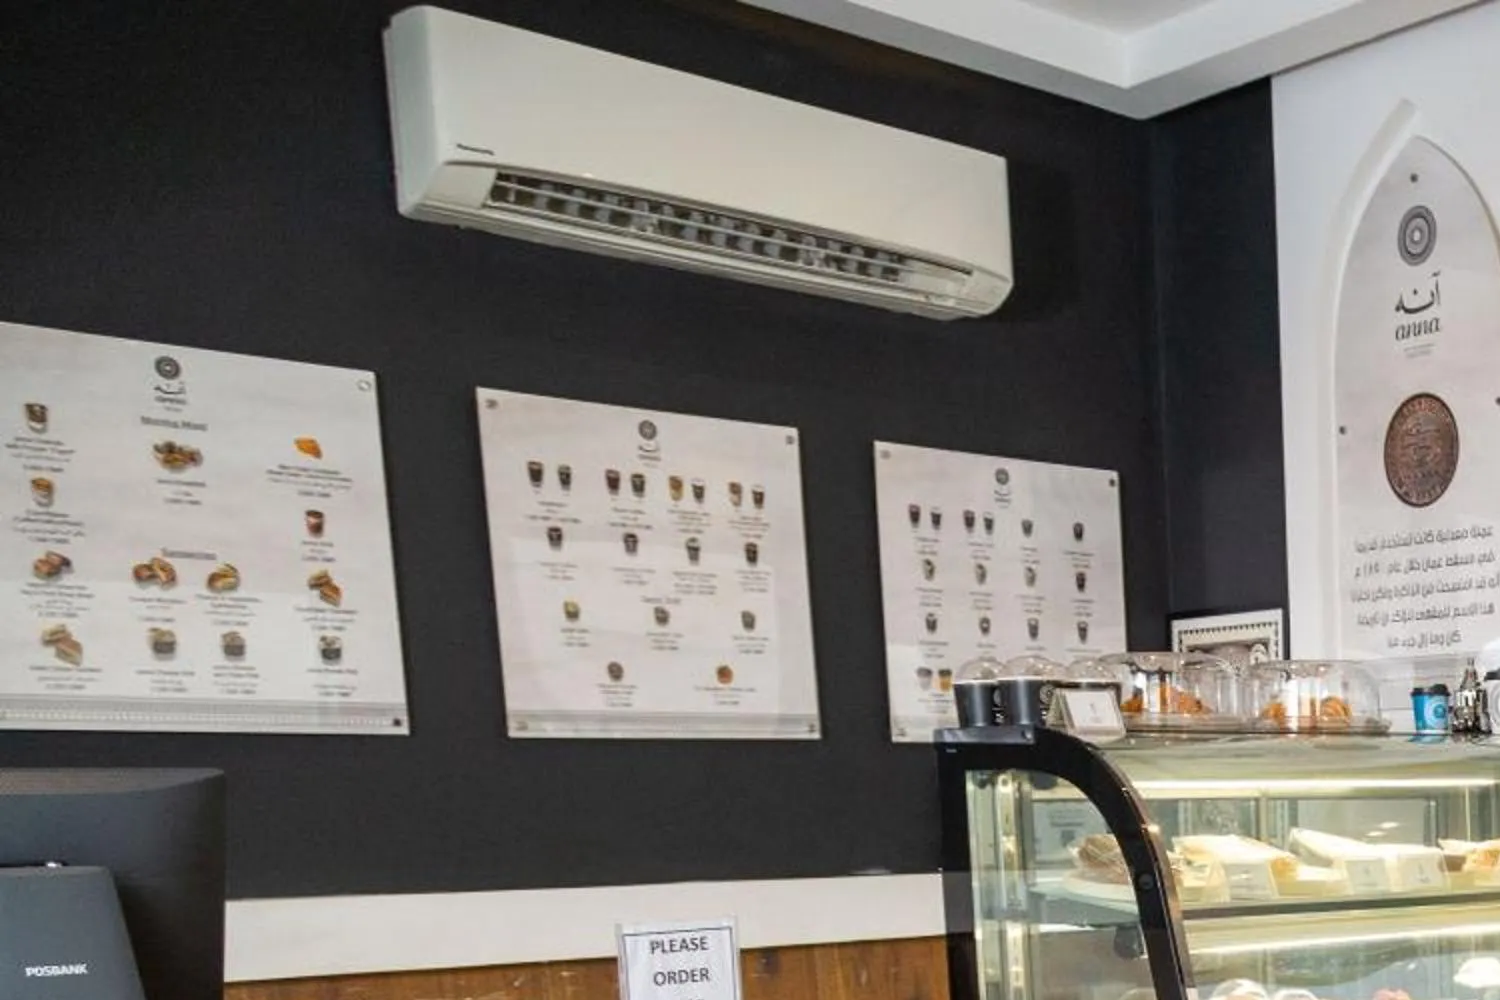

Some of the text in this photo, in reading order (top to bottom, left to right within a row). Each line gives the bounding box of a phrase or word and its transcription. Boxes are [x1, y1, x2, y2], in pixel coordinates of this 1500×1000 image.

[1395, 316, 1442, 341] anna
[651, 936, 709, 954] PLEASE
[25, 963, 88, 977] POSBANK
[653, 967, 711, 987] ORDER
